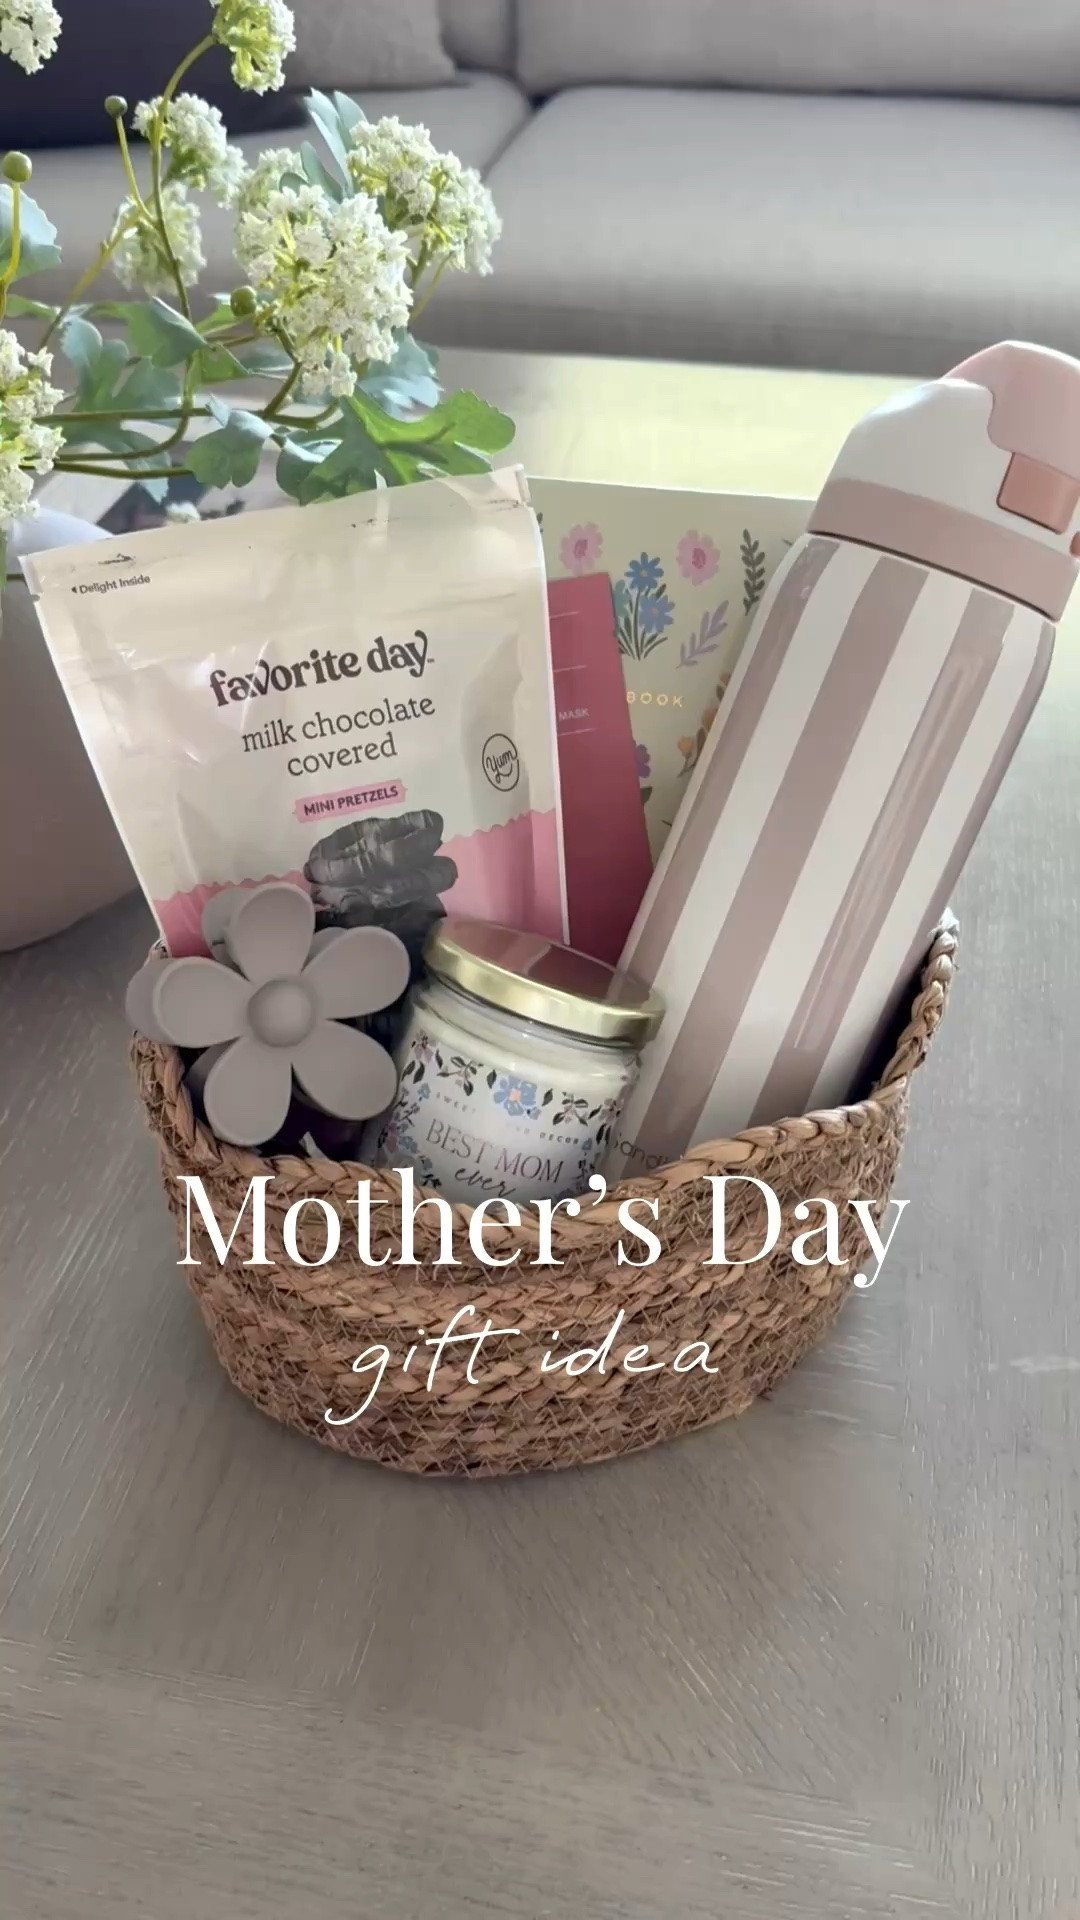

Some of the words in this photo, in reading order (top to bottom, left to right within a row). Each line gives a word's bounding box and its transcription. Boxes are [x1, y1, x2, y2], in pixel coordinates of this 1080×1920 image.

[79, 580, 118, 594] Delight
[119, 574, 151, 587] Inside
[209, 648, 362, 707] favorite
[558, 708, 590, 721] MASK
[626, 691, 683, 708] BOOK
[242, 718, 297, 753] milk
[302, 697, 436, 740] chocolate
[287, 731, 398, 776] covered
[303, 798, 335, 817] MINI
[337, 785, 399, 808] PRETZELS
[425, 1118, 494, 1165] BEST
[494, 1147, 564, 1184] MOM
[454, 1166, 517, 1198] ever
